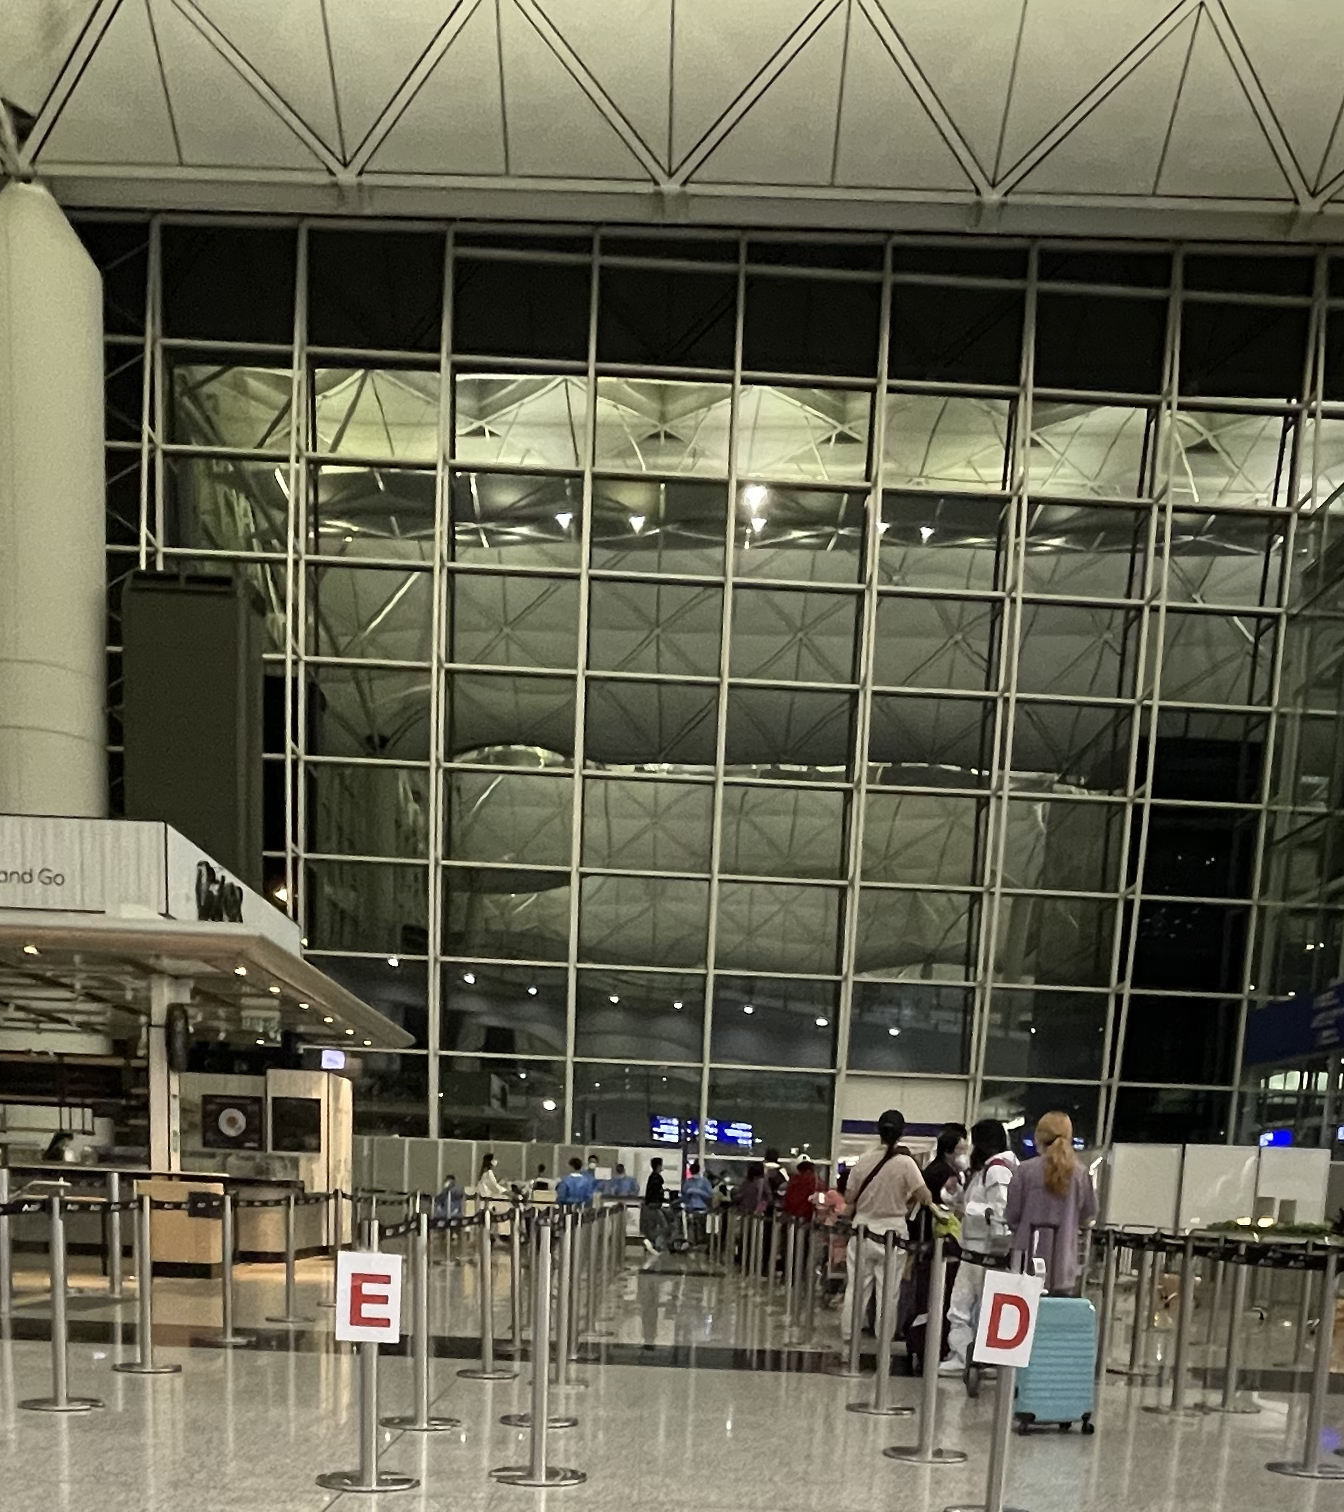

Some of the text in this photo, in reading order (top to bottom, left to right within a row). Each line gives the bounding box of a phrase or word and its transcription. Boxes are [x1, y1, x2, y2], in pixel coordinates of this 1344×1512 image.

[39, 867, 66, 887] Go
[349, 1273, 392, 1329] E
[987, 1294, 1031, 1350] D
